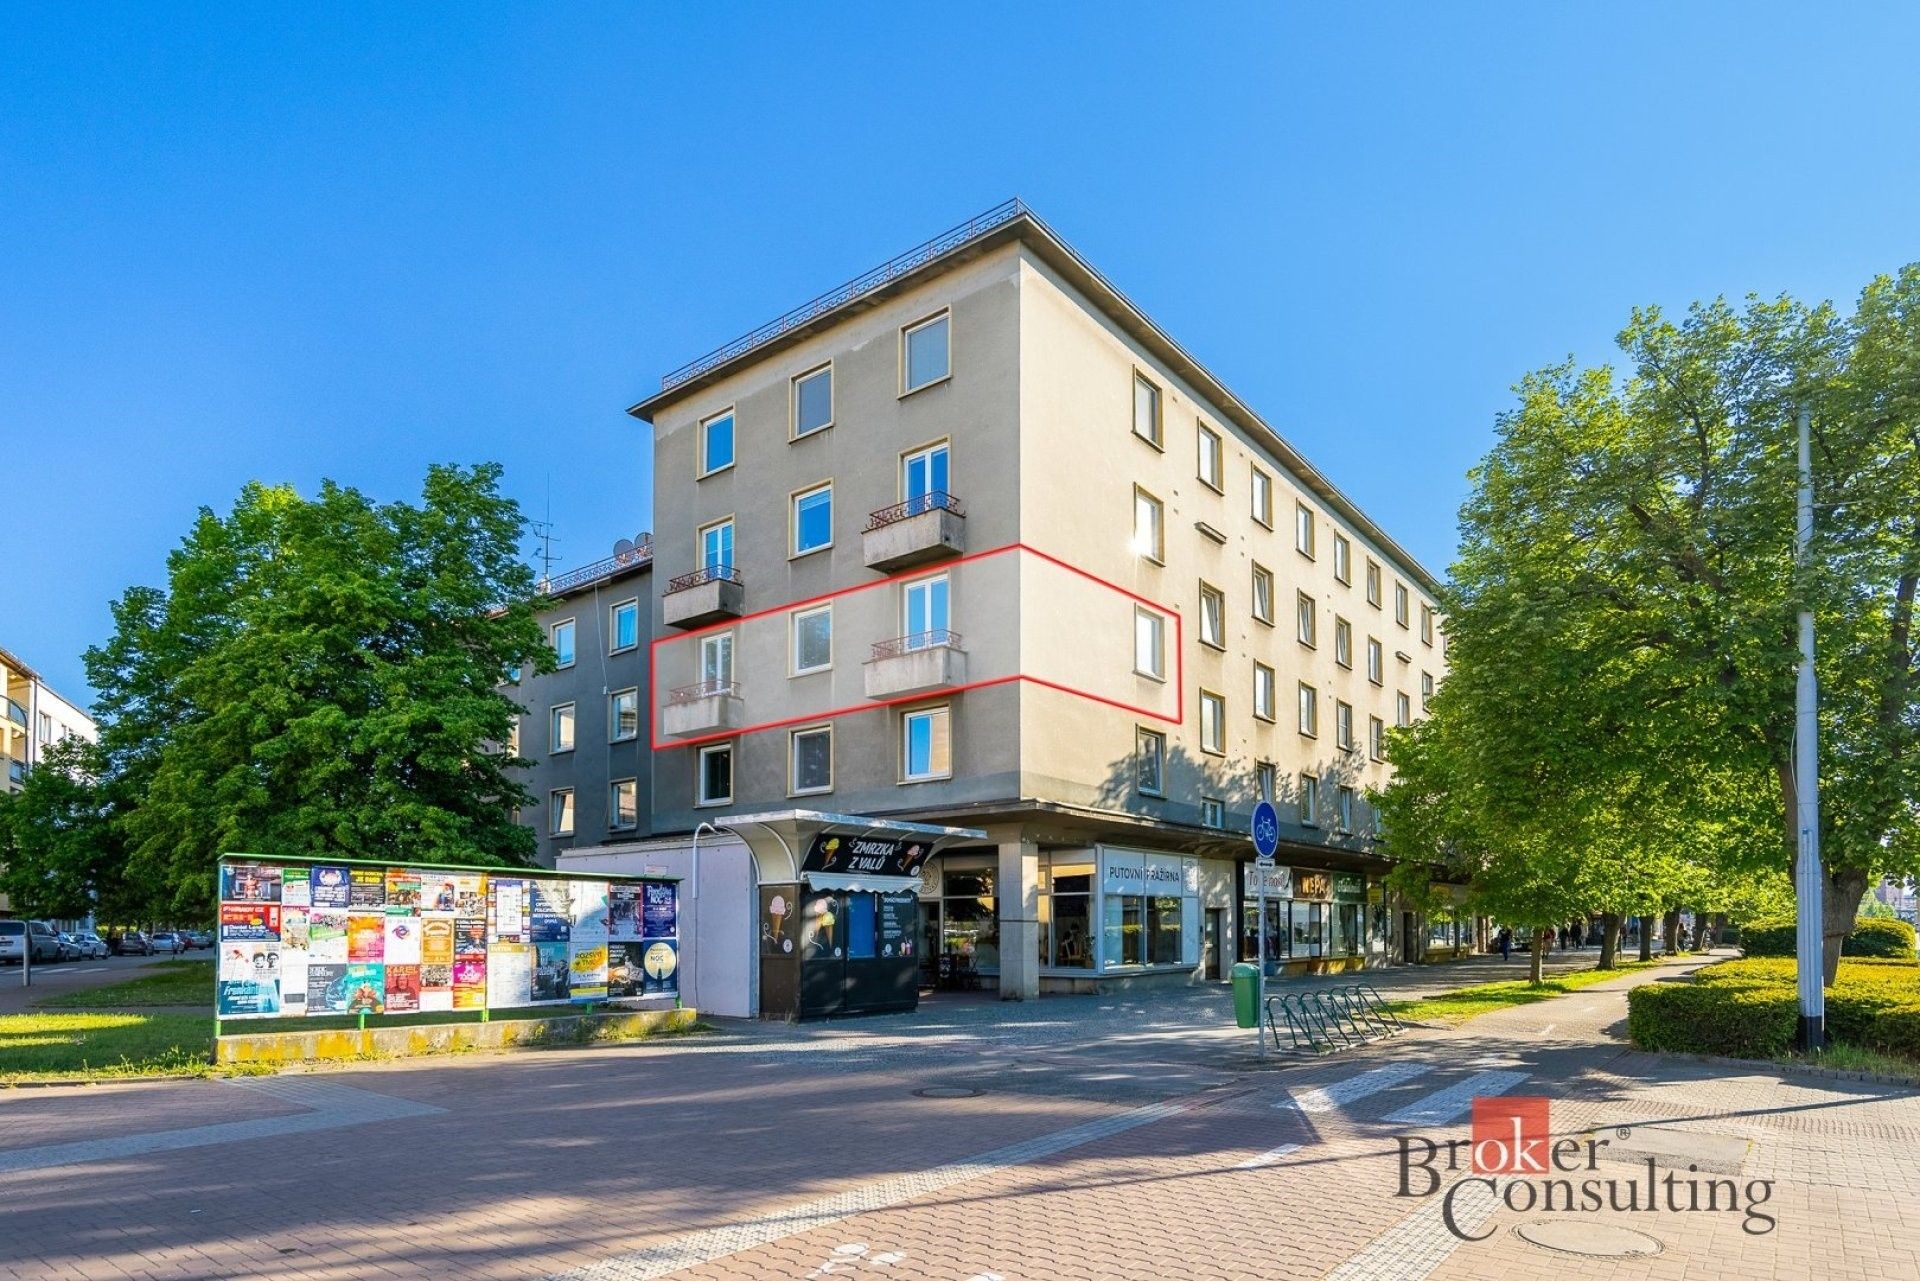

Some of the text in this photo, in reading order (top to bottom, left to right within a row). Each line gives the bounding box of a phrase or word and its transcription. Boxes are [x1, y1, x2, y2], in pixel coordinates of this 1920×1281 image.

[852, 841, 895, 855] ZMRZKA
[848, 856, 860, 869] Z
[1109, 866, 1143, 881] PUTOVNÍ
[386, 966, 418, 974] KAREL
